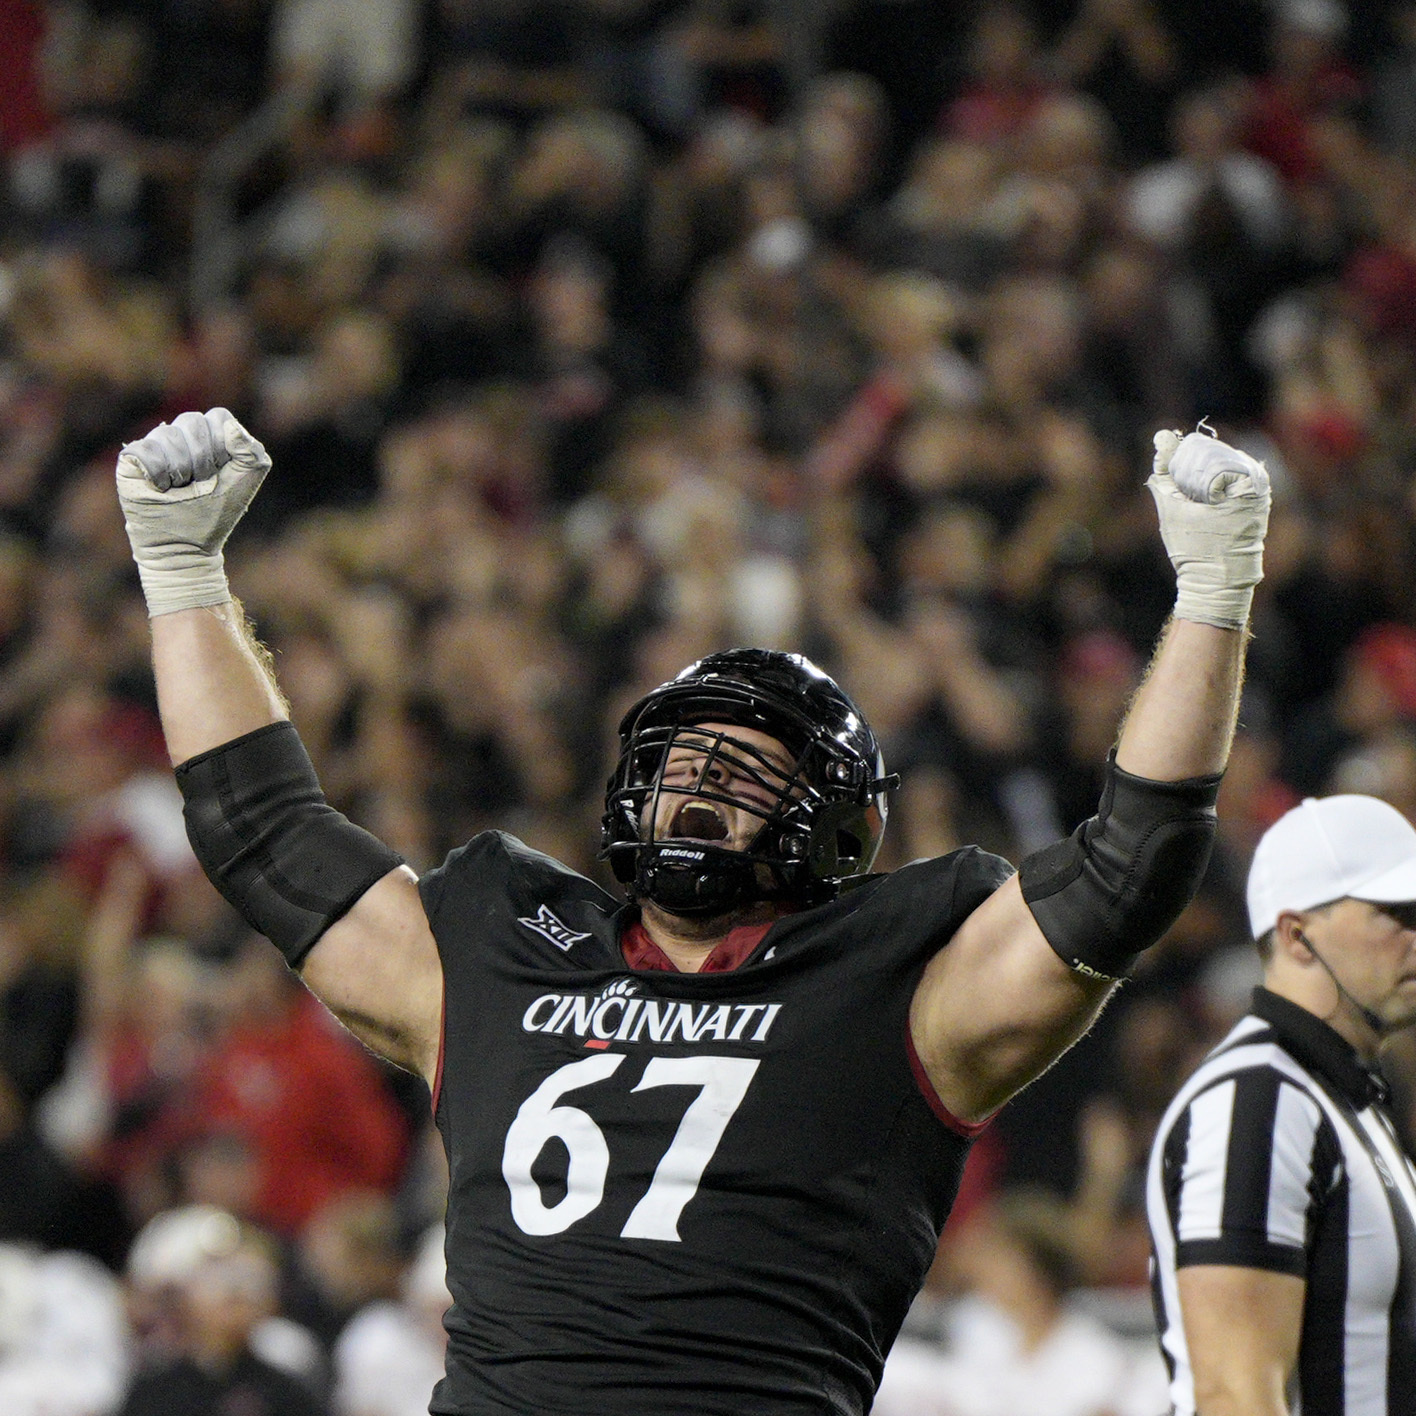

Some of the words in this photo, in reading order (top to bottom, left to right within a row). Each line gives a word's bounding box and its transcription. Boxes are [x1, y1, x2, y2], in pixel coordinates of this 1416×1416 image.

[659, 848, 706, 861] Riddell
[522, 992, 782, 1046] CINCINNATI
[502, 1054, 761, 1242] 67
